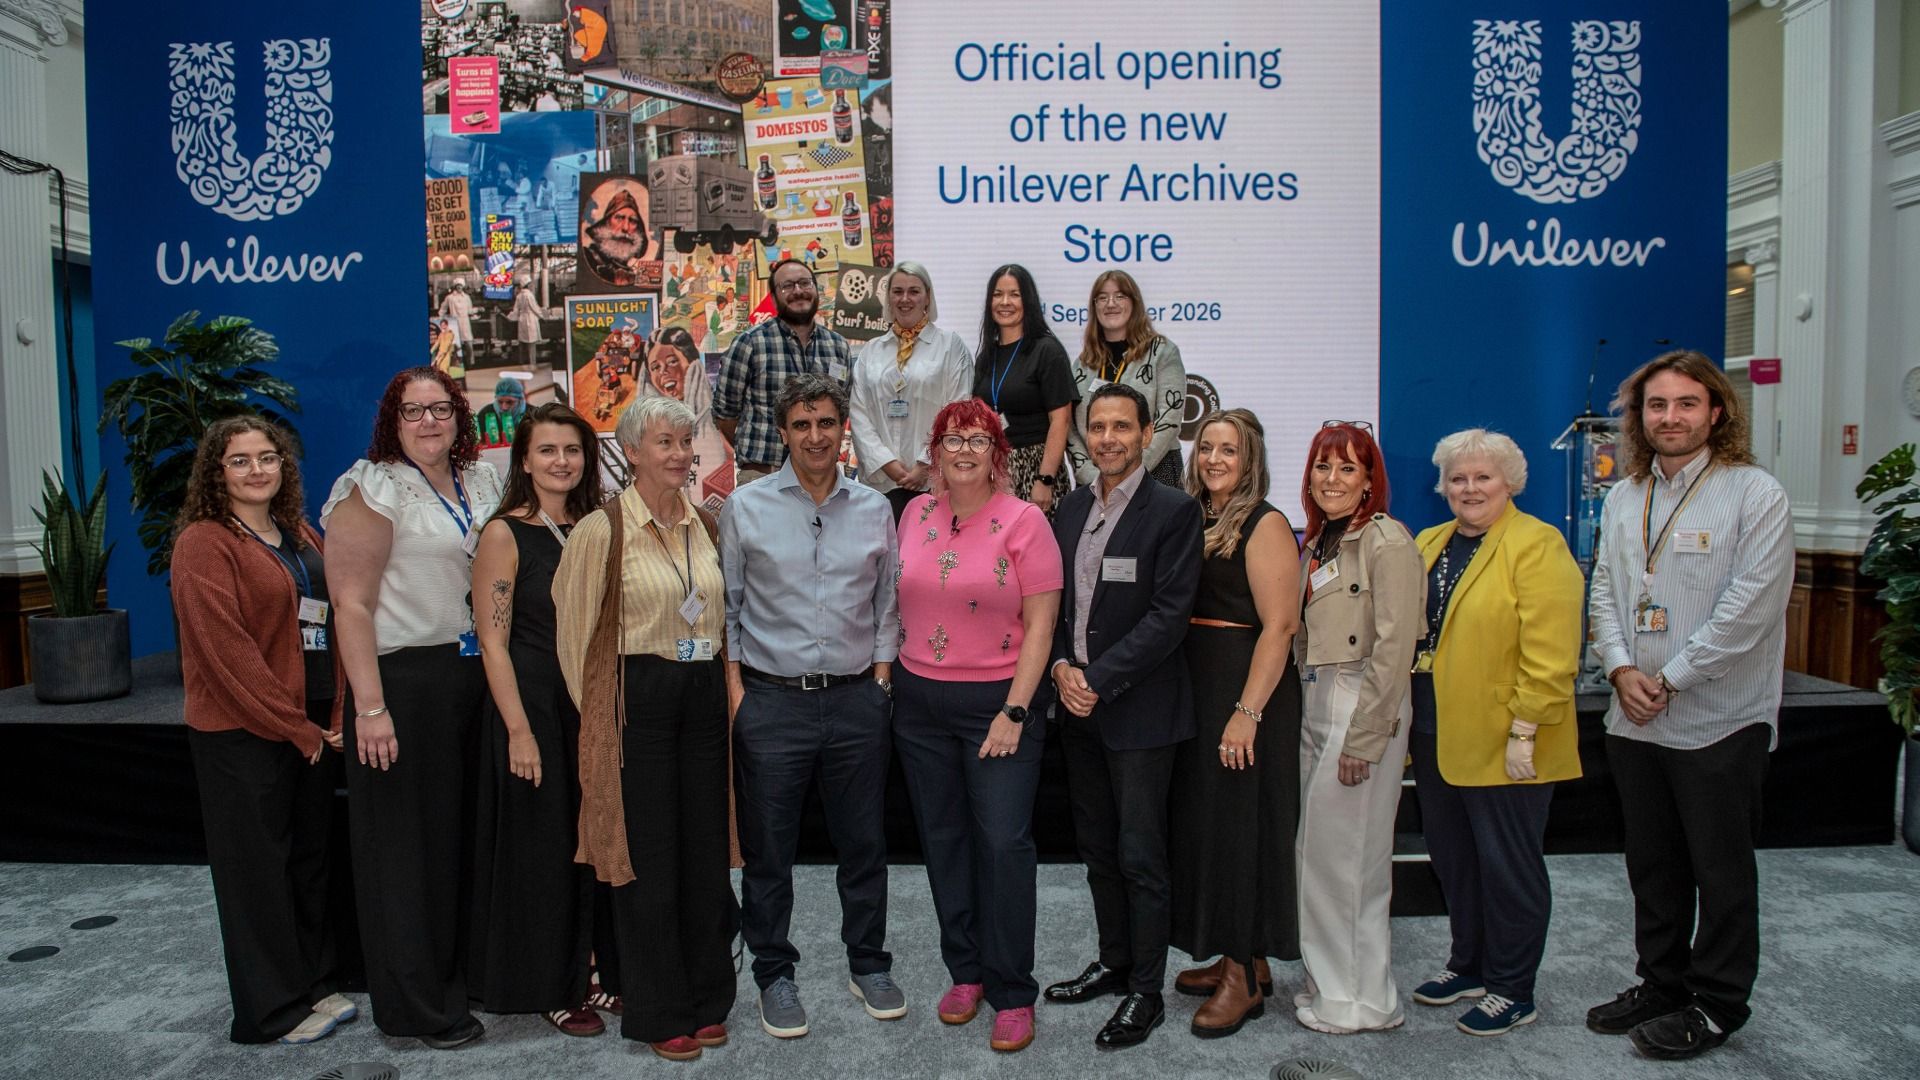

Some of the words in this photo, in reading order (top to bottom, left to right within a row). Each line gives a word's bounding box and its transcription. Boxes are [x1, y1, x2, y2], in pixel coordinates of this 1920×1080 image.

[867, 32, 881, 62] AXE
[721, 63, 761, 78] VASELINE
[955, 42, 1105, 81] Official
[1117, 41, 1281, 89] opening
[620, 68, 669, 91] Welcome
[670, 84, 679, 94] to
[827, 68, 863, 86] Dove
[456, 89, 494, 97] happiness
[756, 119, 828, 139] DOMESTOS
[1010, 104, 1050, 142] of
[1060, 104, 1126, 141] the
[1141, 112, 1227, 141] new
[432, 179, 463, 196] GOOD
[787, 175, 833, 185] safeguards
[939, 165, 1109, 204] Unilever
[1120, 163, 1298, 201] Archives
[444, 196, 463, 209] GET
[430, 212, 444, 224] THE
[446, 210, 466, 222] GOOD
[434, 224, 455, 239] EGG
[782, 223, 815, 231] hundred
[817, 221, 838, 229] ways
[437, 238, 468, 252] AWARD
[491, 231, 513, 243] SKY
[1064, 224, 1172, 263] Store
[1453, 218, 1665, 266] Unilever
[157, 236, 362, 285] Unilever
[575, 301, 648, 314] SUNLIGHT
[1051, 303, 1166, 327] Seper
[1171, 303, 1221, 321] 2026
[575, 315, 615, 328] SOAP
[836, 309, 864, 328] Surf
[864, 315, 890, 331] boils
